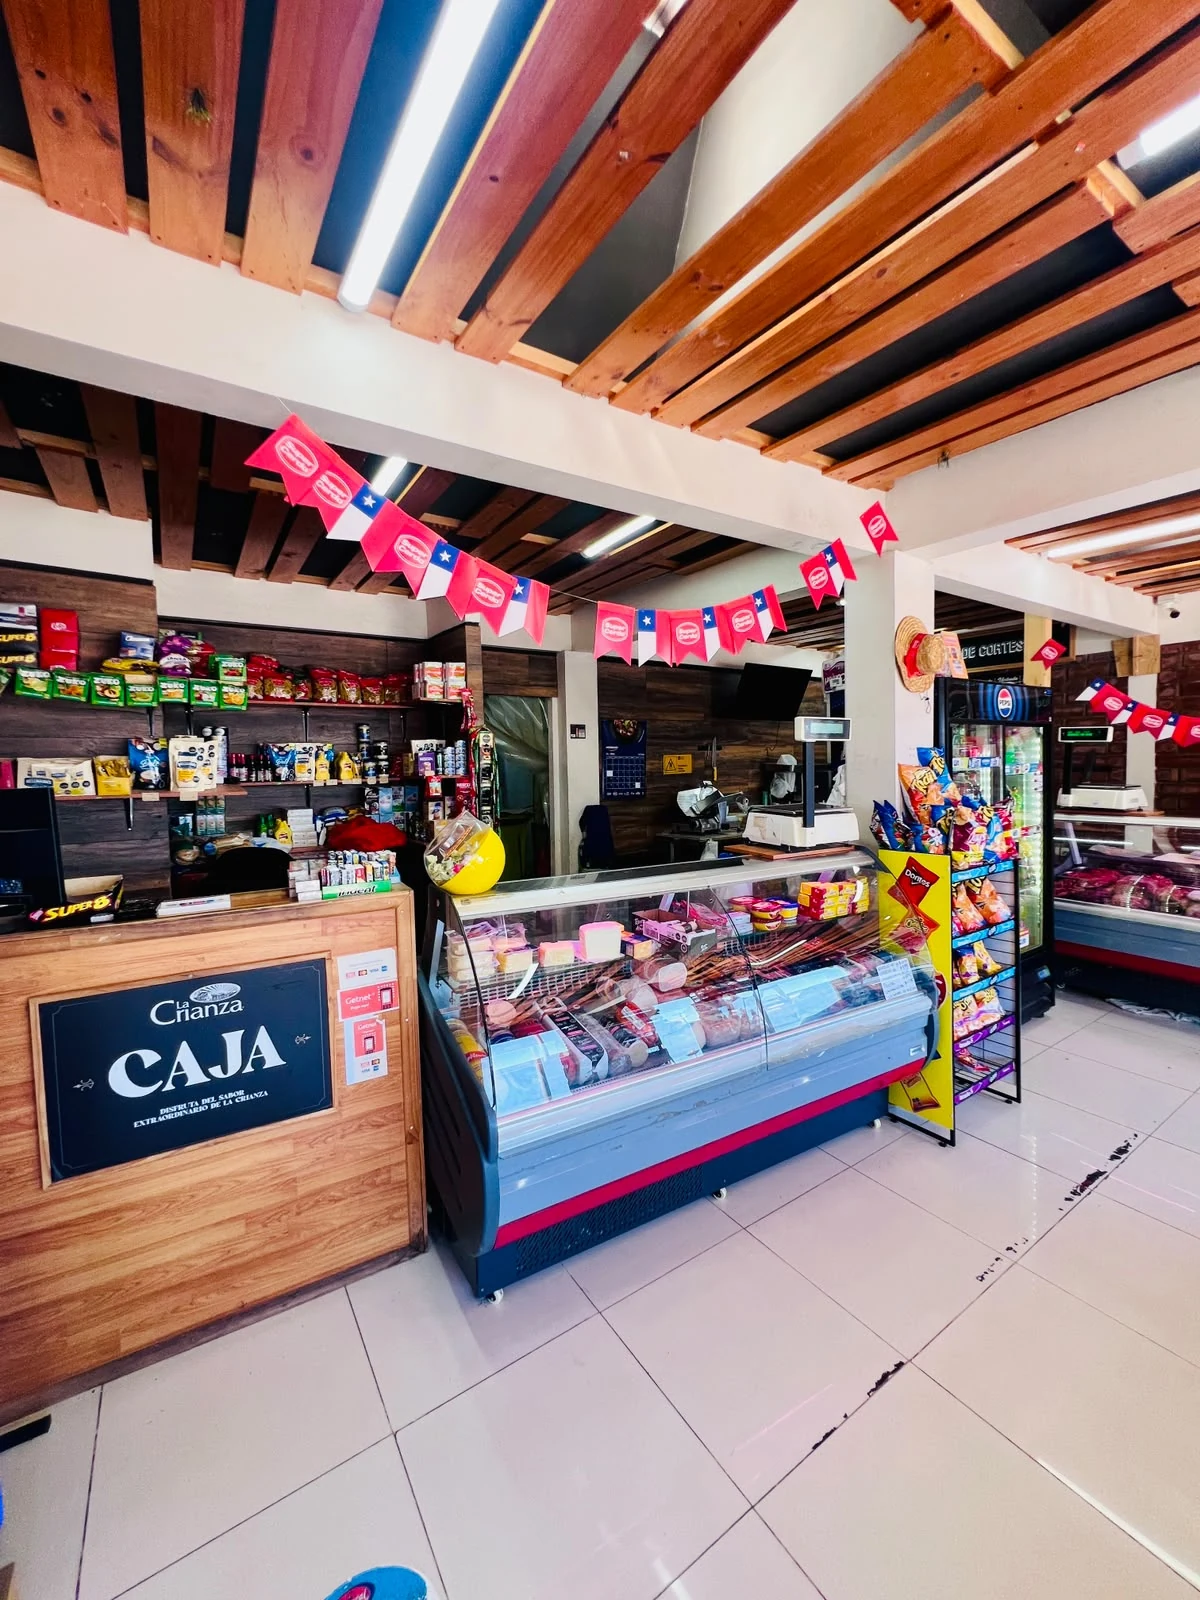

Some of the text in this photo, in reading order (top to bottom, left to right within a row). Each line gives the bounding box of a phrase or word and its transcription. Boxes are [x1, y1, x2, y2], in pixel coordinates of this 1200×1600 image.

[978, 640, 1025, 658] CORTES
[904, 868, 931, 888] Doritos
[41, 895, 111, 923] SUPER 8
[176, 1000, 190, 1010] La
[344, 993, 372, 1005] Getnet
[150, 1000, 244, 1026] Crianza
[108, 1025, 287, 1098] CAJA
[133, 1104, 209, 1128] EXTRAORDINARIO
[210, 1101, 222, 1109] DE
[235, 1090, 269, 1103] CRIANZA
[160, 1089, 245, 1115] DISFRUTA DEL SABOR
